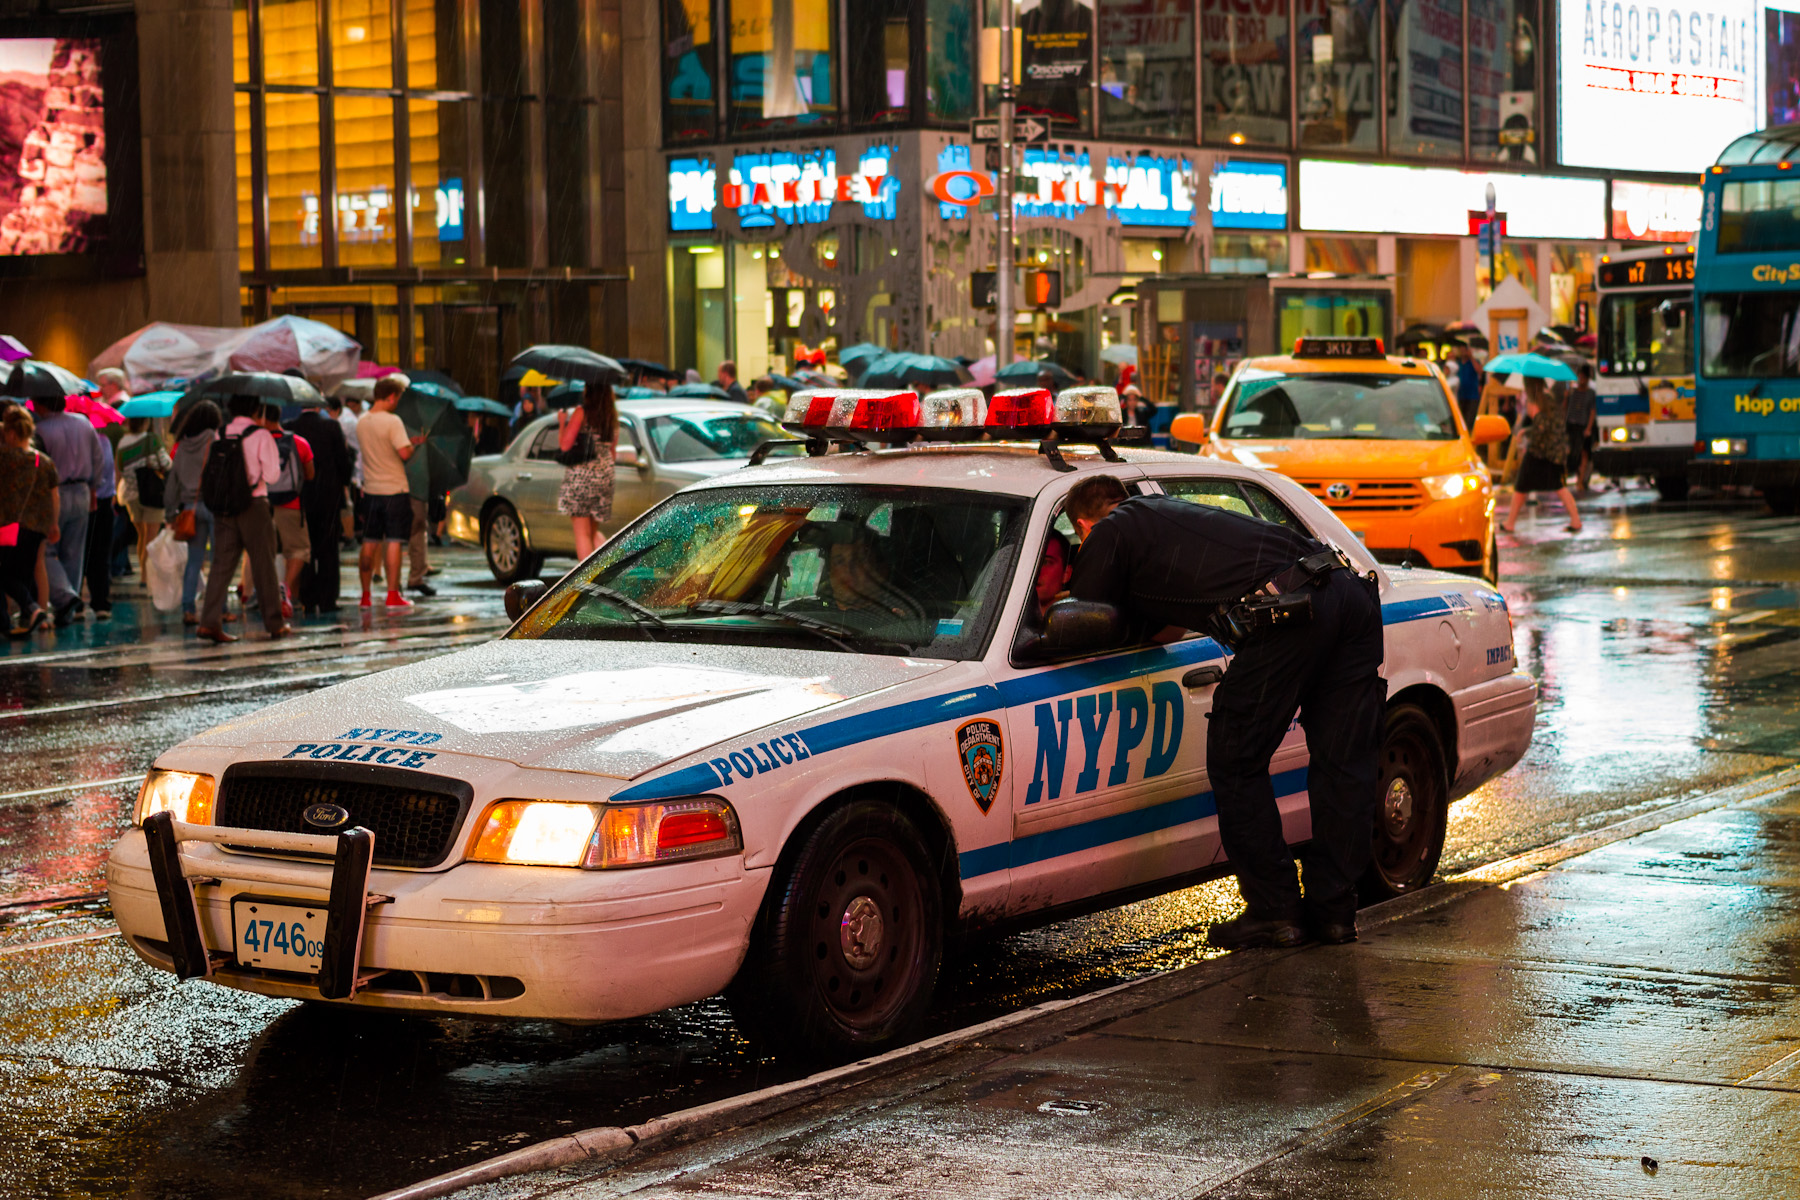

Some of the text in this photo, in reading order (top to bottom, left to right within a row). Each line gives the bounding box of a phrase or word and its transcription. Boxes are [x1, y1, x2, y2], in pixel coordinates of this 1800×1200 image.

[1735, 394, 1775, 416] Hop
[1487, 645, 1511, 666] IMPACT
[336, 728, 443, 745] NYPD
[965, 723, 991, 738] POLICE
[960, 733, 1001, 755] DEPARTMENT
[1024, 680, 1185, 806] NYPD
[282, 744, 438, 769] POLICE
[709, 732, 810, 787] POLICE
[963, 764, 981, 800] CITY OF
[988, 752, 1003, 802] NEW YORK
[312, 807, 337, 822] Ford
[244, 919, 307, 957] 4746
